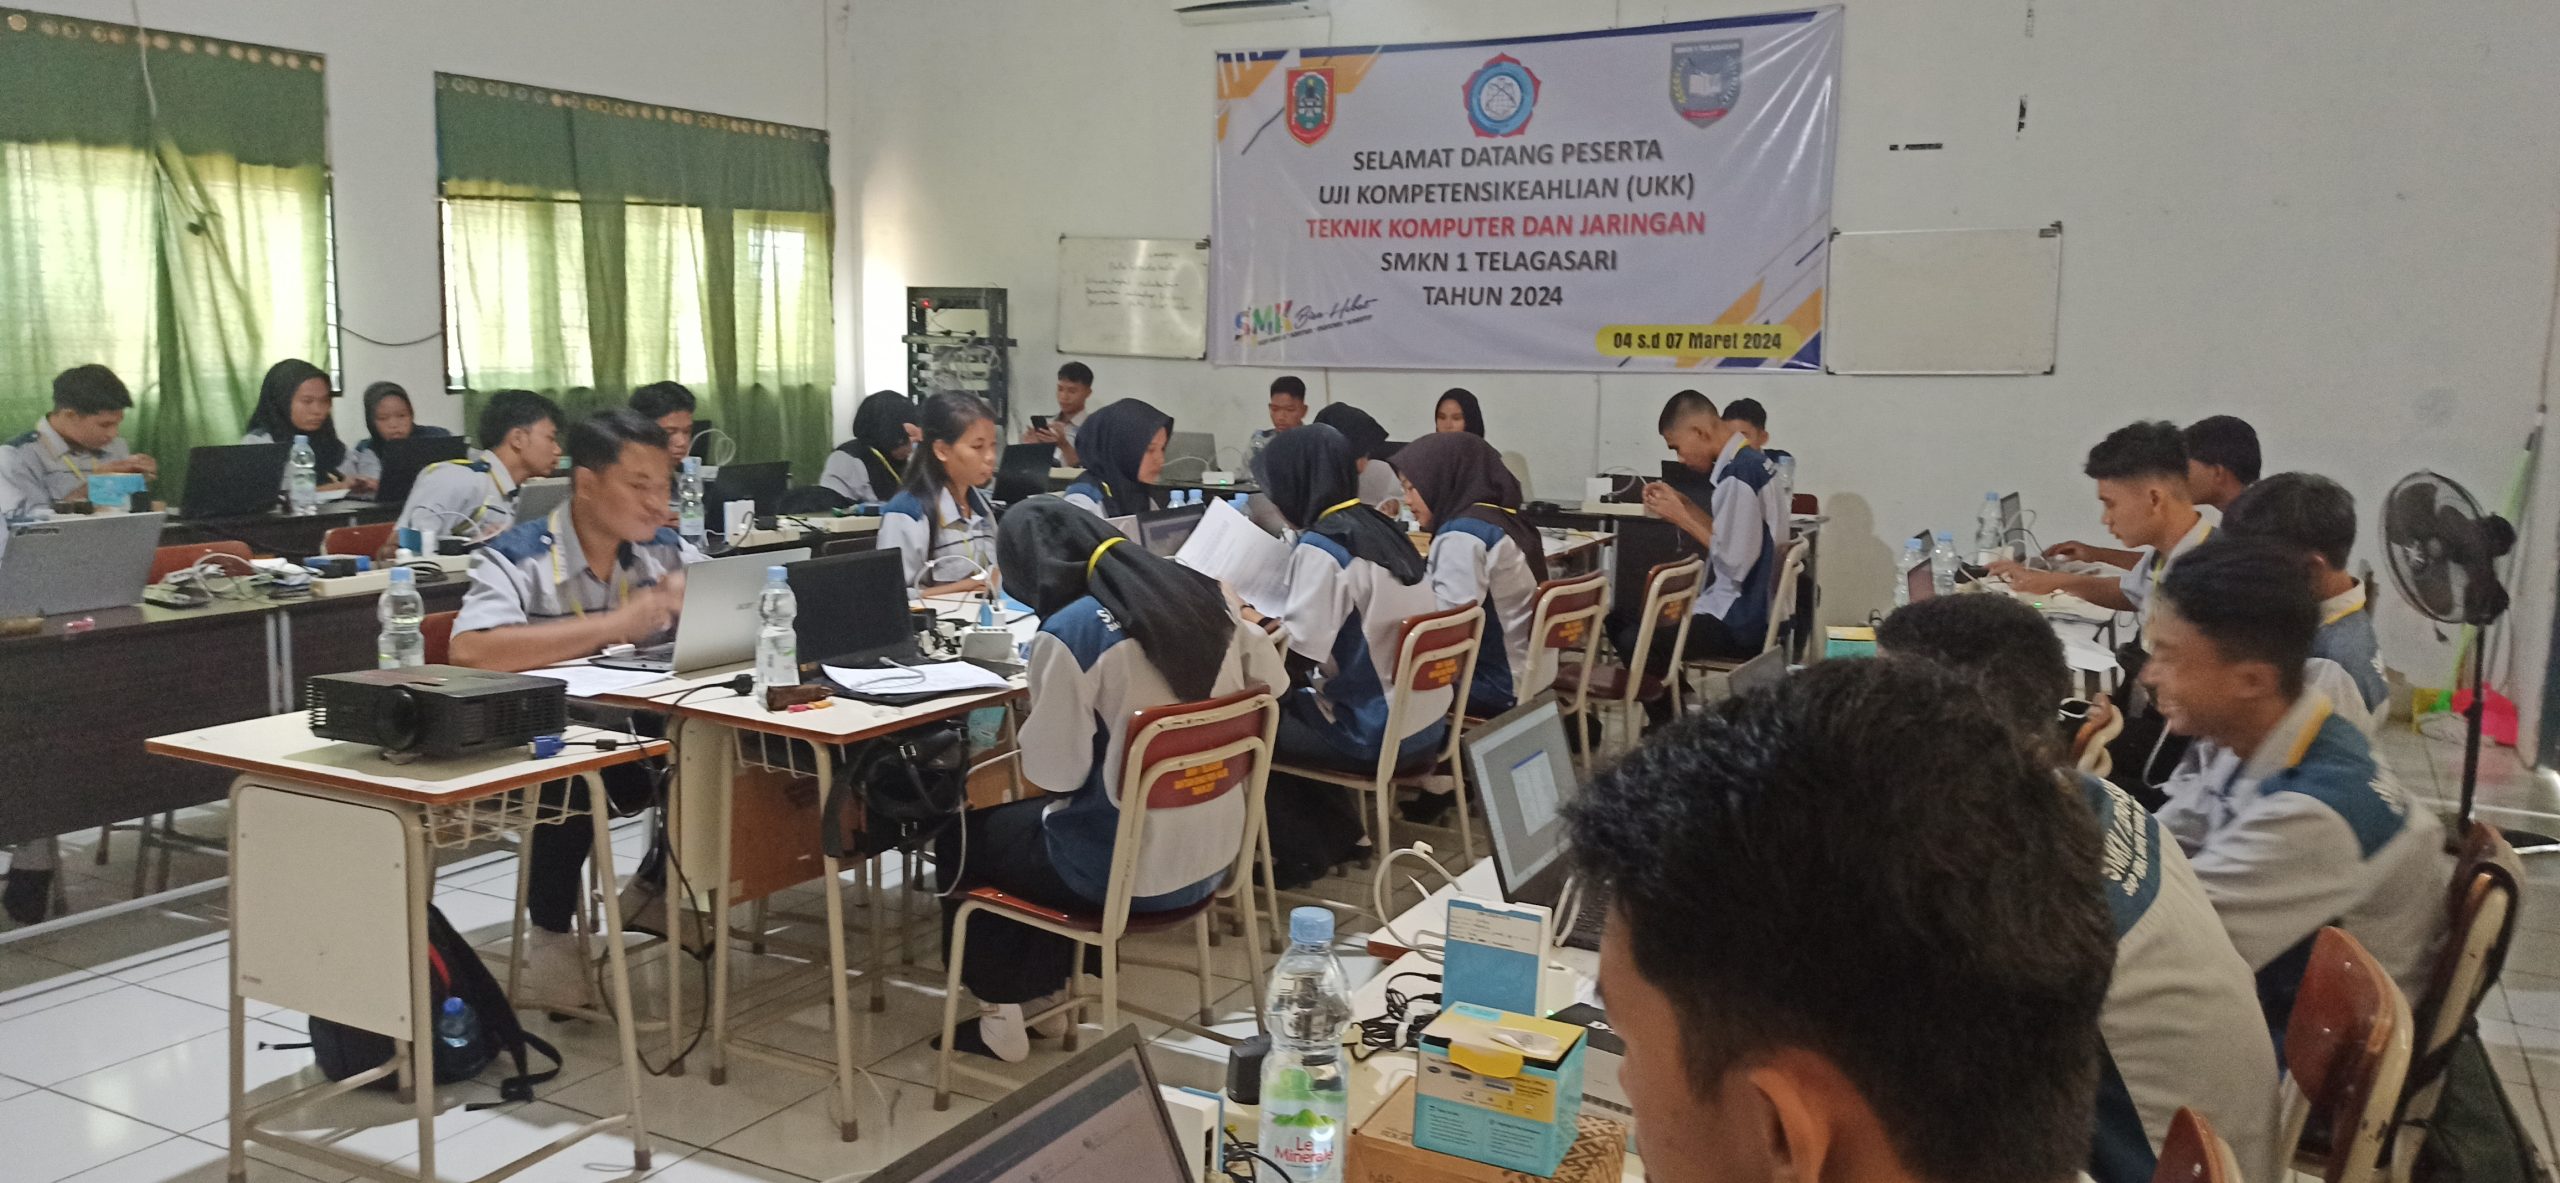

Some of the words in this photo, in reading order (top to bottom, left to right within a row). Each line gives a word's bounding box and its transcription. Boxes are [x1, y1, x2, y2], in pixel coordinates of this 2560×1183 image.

[1353, 148, 1454, 171] SELAMAT
[1460, 144, 1553, 168] DATANG
[1561, 139, 1663, 163] PESERTA
[1319, 185, 1350, 204] UJI
[1357, 178, 1619, 204] KOMPETENSIKEAHLIAN
[1627, 172, 1695, 201] (UKK)
[1306, 218, 1382, 238] TEKNIK
[1389, 216, 1515, 239] KOMPUTER
[1522, 214, 1573, 237] DAN
[1580, 211, 1706, 236] JARINGAN
[1380, 252, 1449, 271] SMKN
[1456, 252, 1468, 272] 1
[1475, 250, 1618, 272] TELAGASARI
[1423, 286, 1503, 306] TAHUN
[1510, 286, 1563, 306] 2024
[1234, 299, 1294, 336] SMK
[1613, 332, 1632, 349] 04
[1637, 332, 1660, 349] s.d
[1666, 332, 1684, 349] 07
[1689, 332, 1738, 349] Maret
[1743, 332, 1782, 349] 2024
[1274, 1145, 1334, 1164] Minerale
[1296, 1136, 1313, 1151] Le
